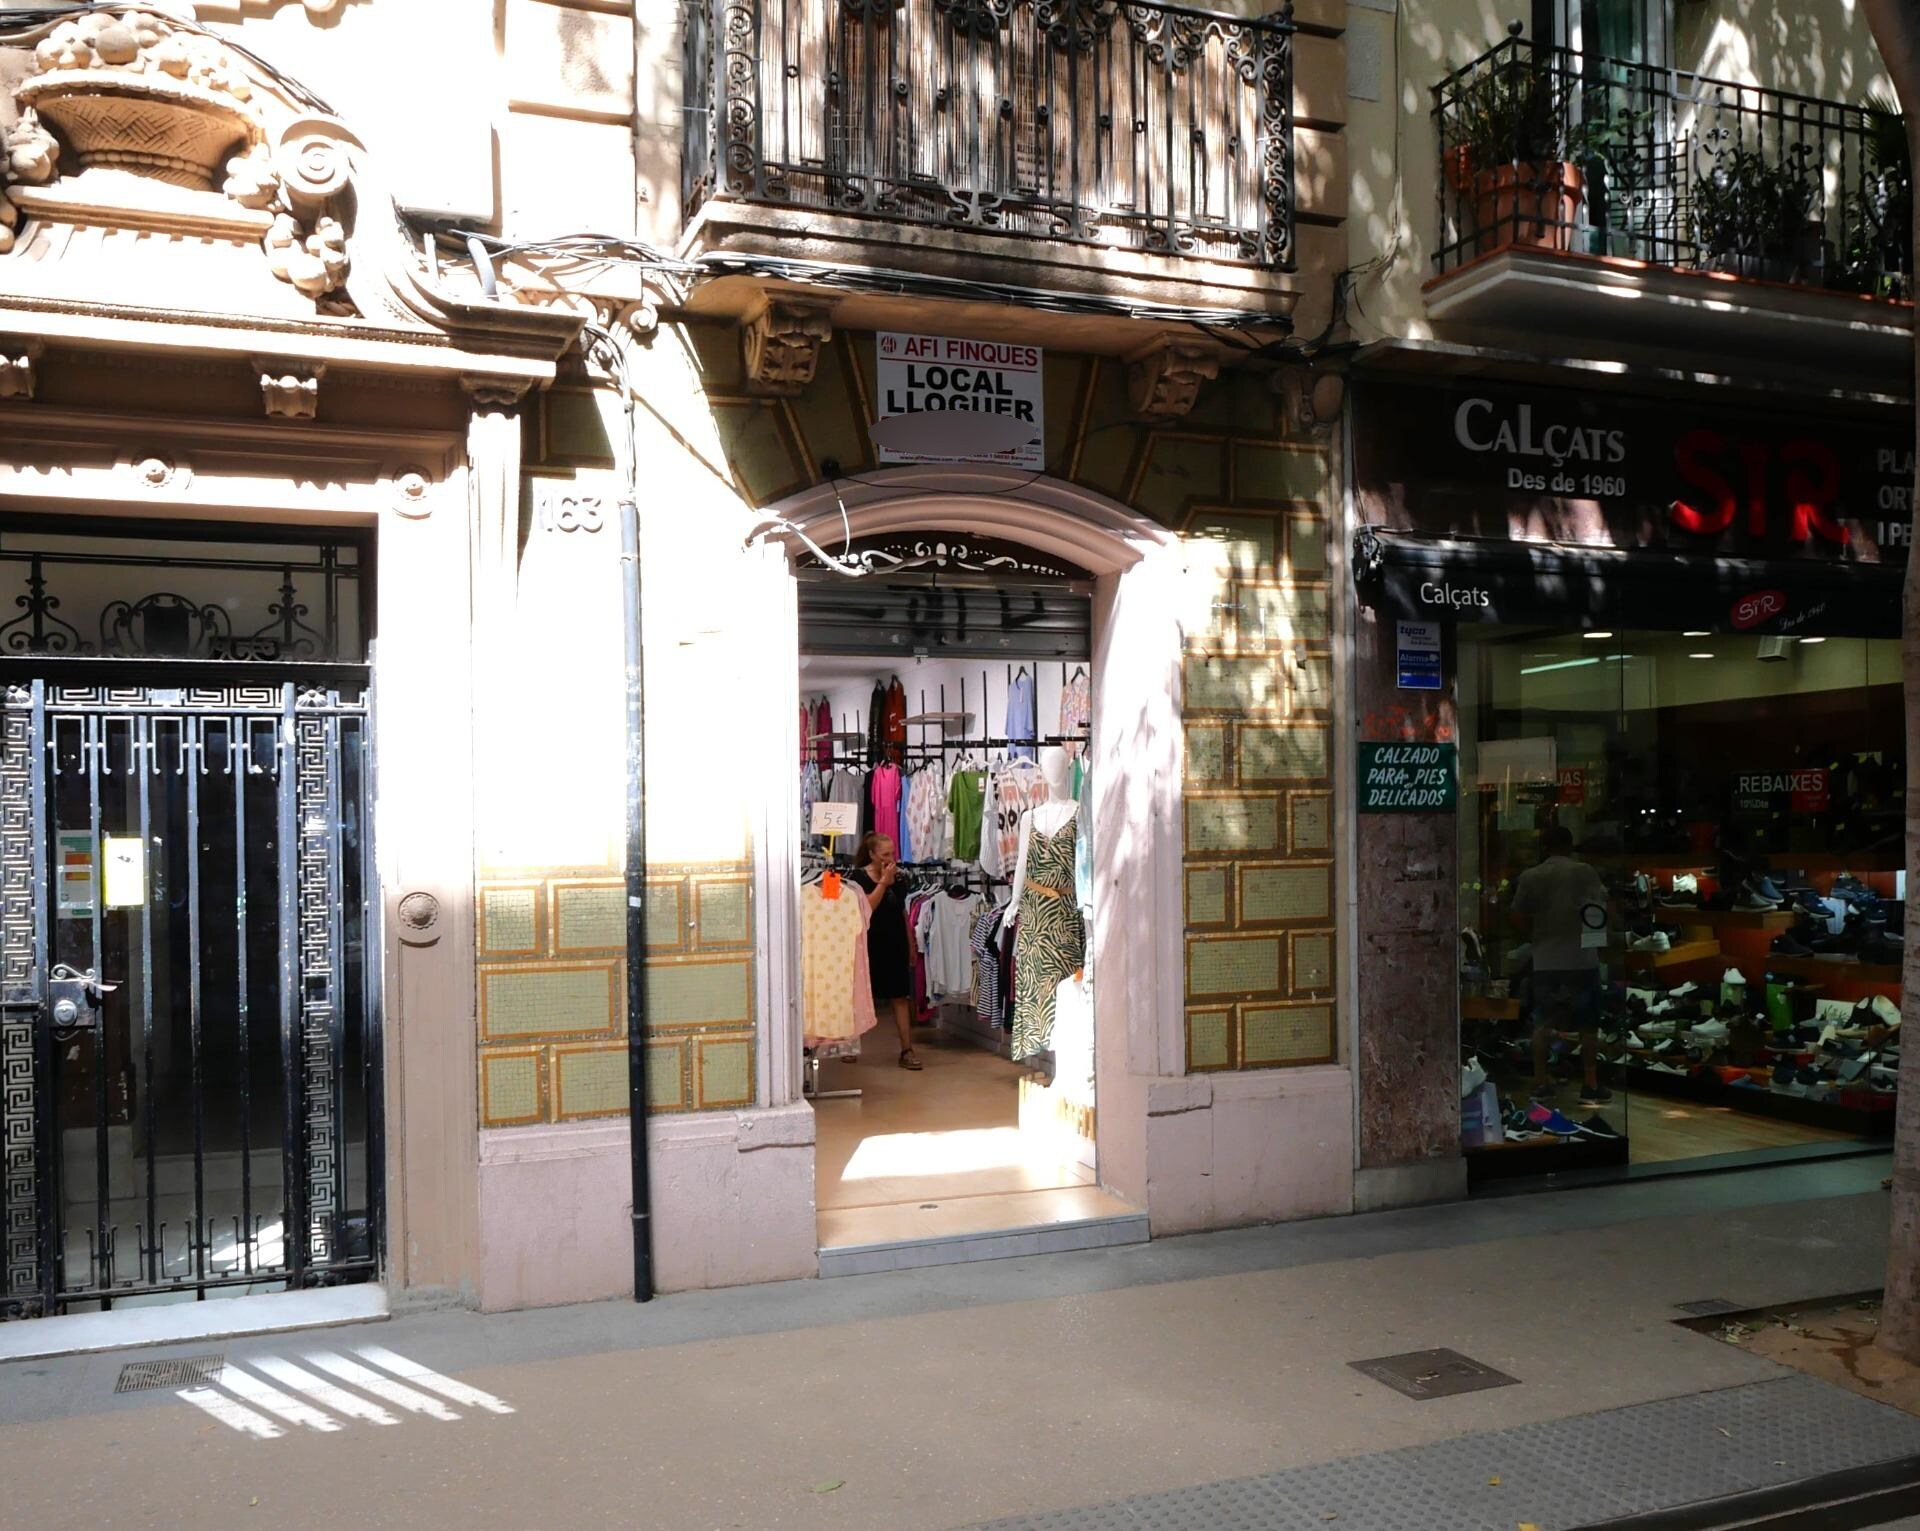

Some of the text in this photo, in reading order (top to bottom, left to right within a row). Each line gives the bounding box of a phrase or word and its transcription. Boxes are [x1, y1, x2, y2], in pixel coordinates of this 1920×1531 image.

[904, 336, 1038, 367] AFI FINQUES
[907, 364, 1013, 396] LOCAL
[1508, 467, 1626, 497] Des de 1960
[1668, 427, 1850, 545] SIR
[540, 496, 604, 533] 163
[1420, 582, 1489, 610] Calçats
[1400, 625, 1426, 637] tyco
[1374, 747, 1440, 765] CALZADO
[1414, 768, 1448, 786] PIES
[1739, 773, 1823, 793] REBAIXES
[1367, 788, 1447, 807] DELICADOS
